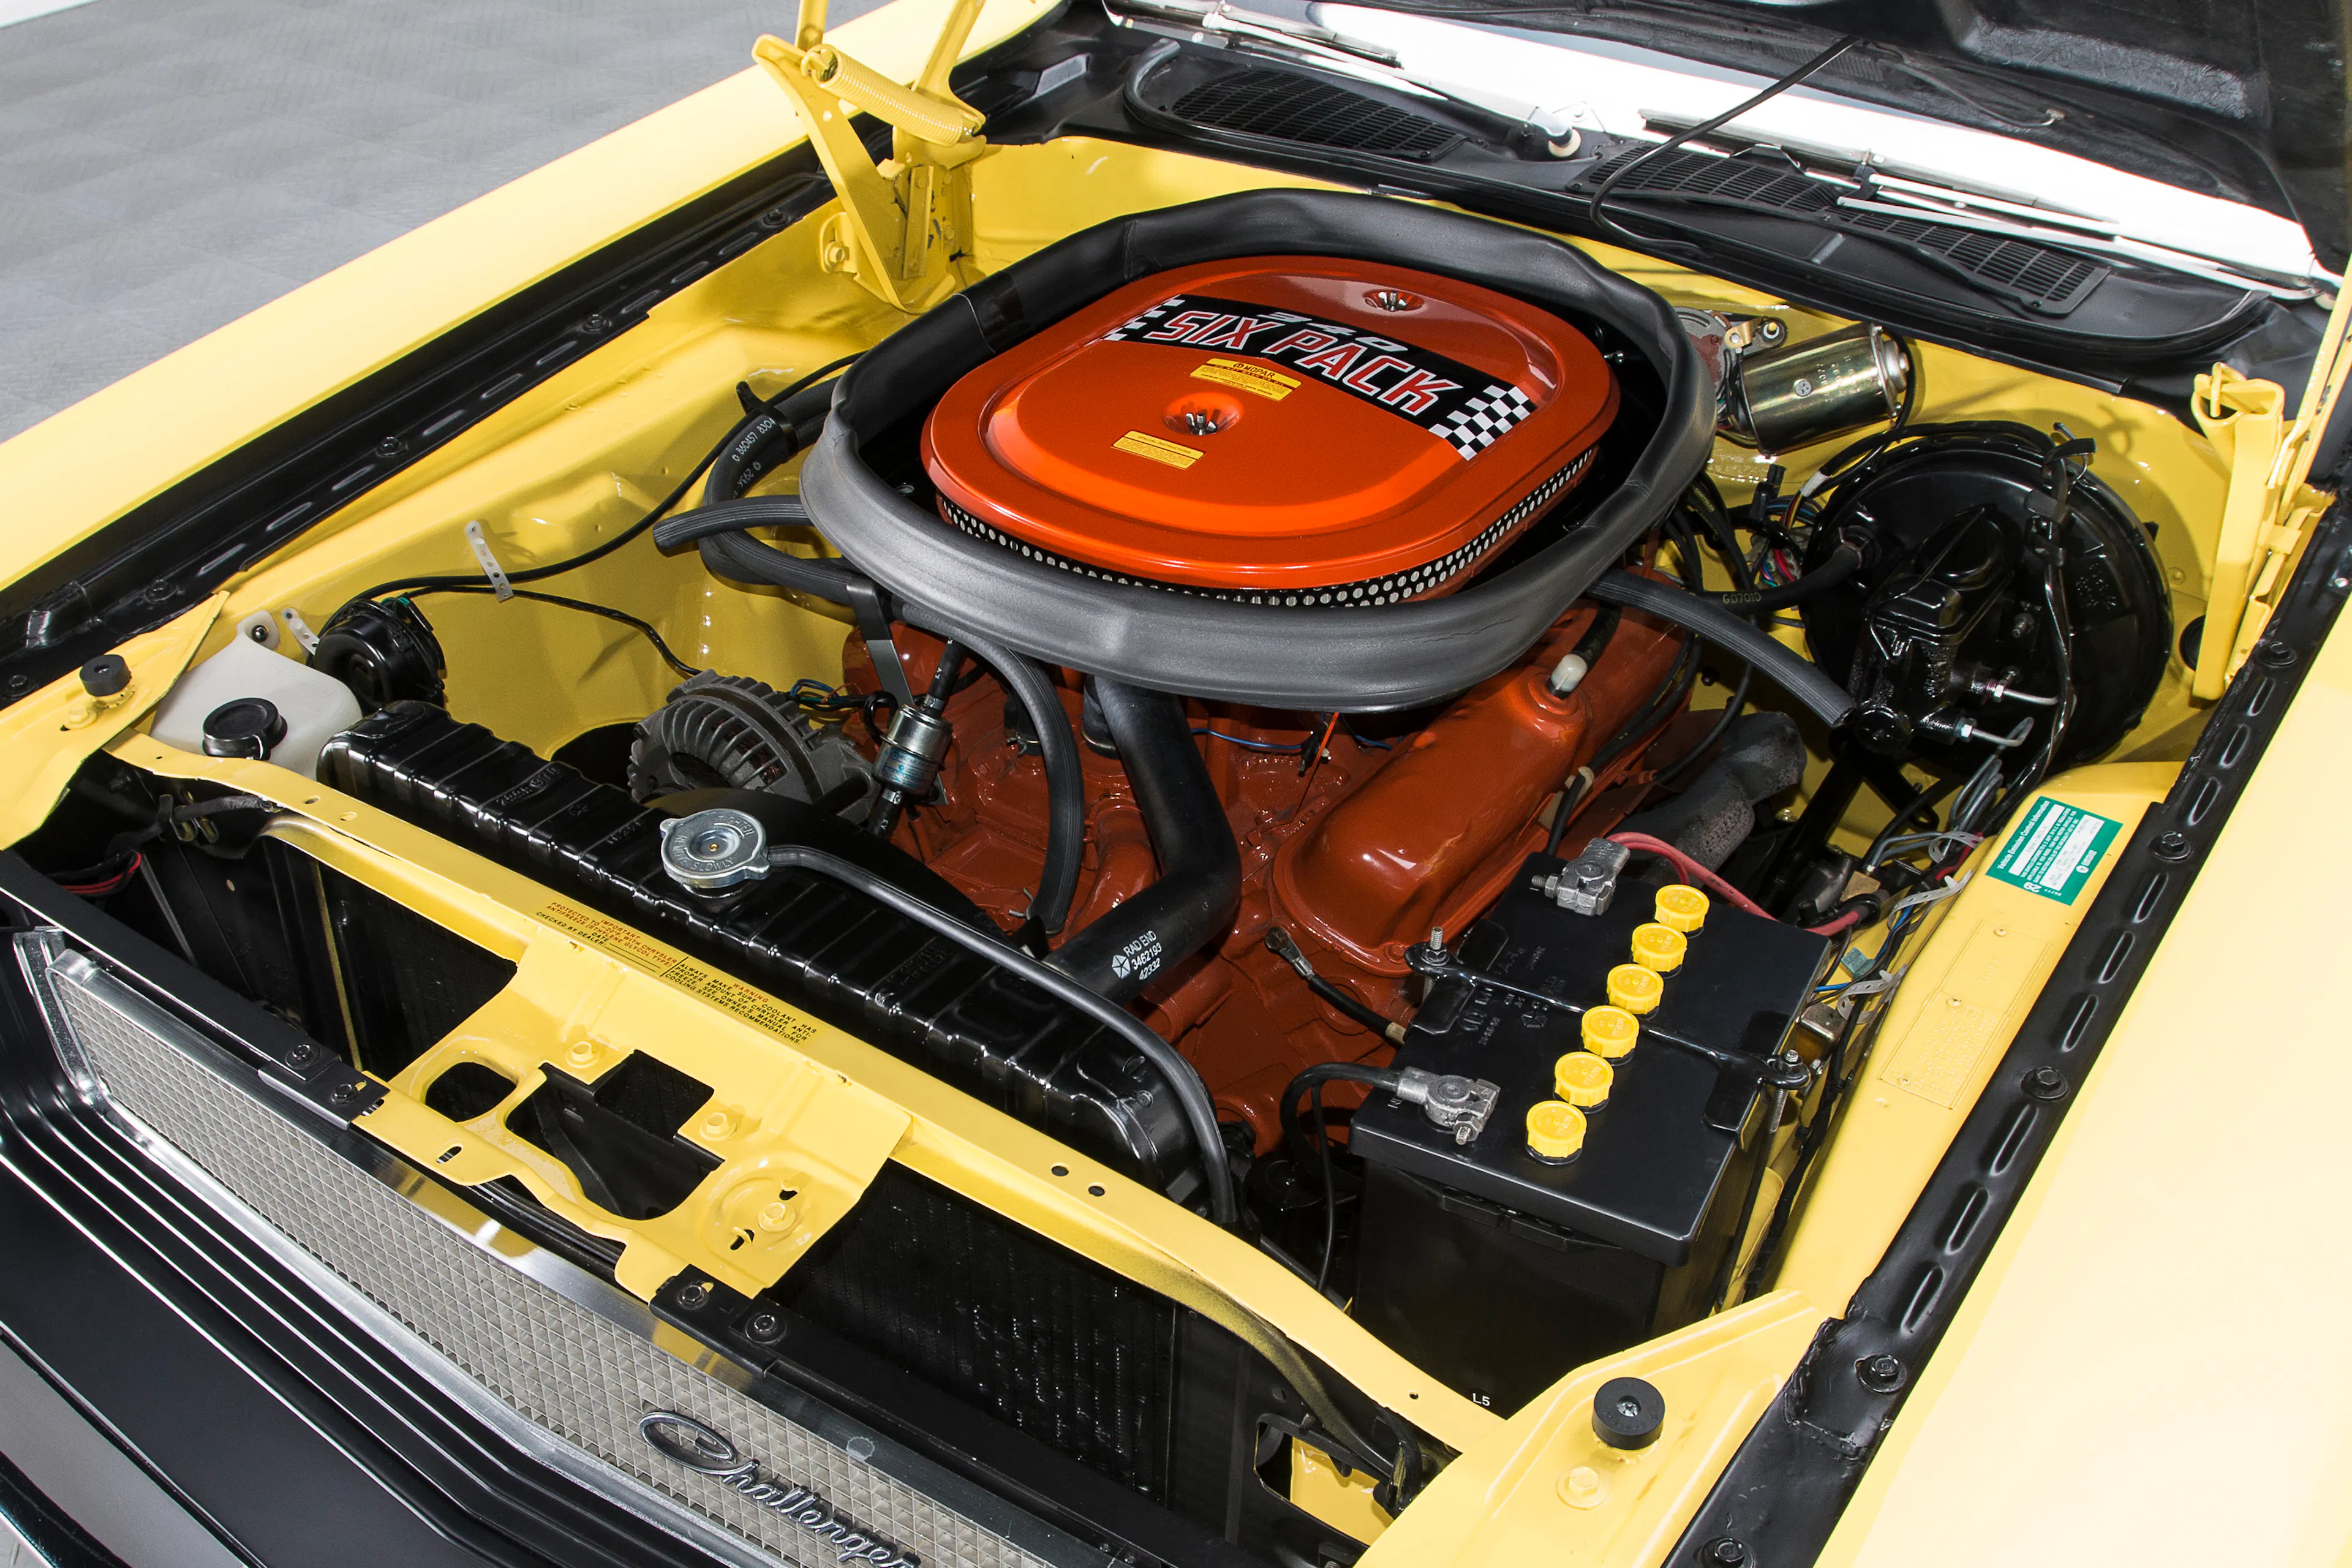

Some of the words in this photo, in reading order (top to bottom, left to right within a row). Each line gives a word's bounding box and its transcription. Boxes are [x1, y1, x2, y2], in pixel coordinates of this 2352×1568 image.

[1257, 311, 1408, 352] 340
[1143, 311, 1286, 350] SIX
[1261, 329, 1463, 417] PACK
[1242, 365, 1276, 379] MOPAR
[535, 910, 567, 928] CHECKED
[545, 904, 586, 926] ANTIFREEZE
[584, 923, 624, 944] (ETHYLENE
[623, 941, 652, 957] GLYCOL
[650, 954, 673, 968] TYPE)
[550, 901, 590, 922] PROTECTED
[622, 935, 641, 946] WITH
[640, 944, 678, 964] CHRYSLER
[600, 918, 641, 940] IMPORTANT
[590, 932, 610, 942] DATE
[1123, 940, 1142, 957] RAD
[1142, 930, 1157, 947] END
[1131, 942, 1163, 970] 3462193
[1139, 957, 1161, 981] 42332
[664, 973, 697, 990] COOLING
[695, 989, 730, 1007] SYSTEMS
[727, 1005, 804, 1045] RECOMMENDATIONS.
[669, 970, 700, 986] FREEZE.
[701, 986, 718, 995] SEE
[720, 995, 754, 1013] OWNER'S
[755, 1013, 788, 1031] MANUAL
[790, 1031, 808, 1041] FOR
[674, 966, 704, 982] PROPER
[704, 981, 736, 998] AMOUNT
[750, 1004, 790, 1025] CHRYSLER
[791, 1025, 813, 1037] ANTI-
[679, 963, 709, 979] ALWAYS
[711, 978, 733, 991] MAKE
[736, 991, 758, 1003] SURE
[760, 1003, 797, 1023] COOLANT
[799, 1023, 818, 1034] HAS
[731, 982, 770, 1003] WARNING
[1472, 1392, 1490, 1406] L5
[639, 1411, 922, 1568] Challenger
